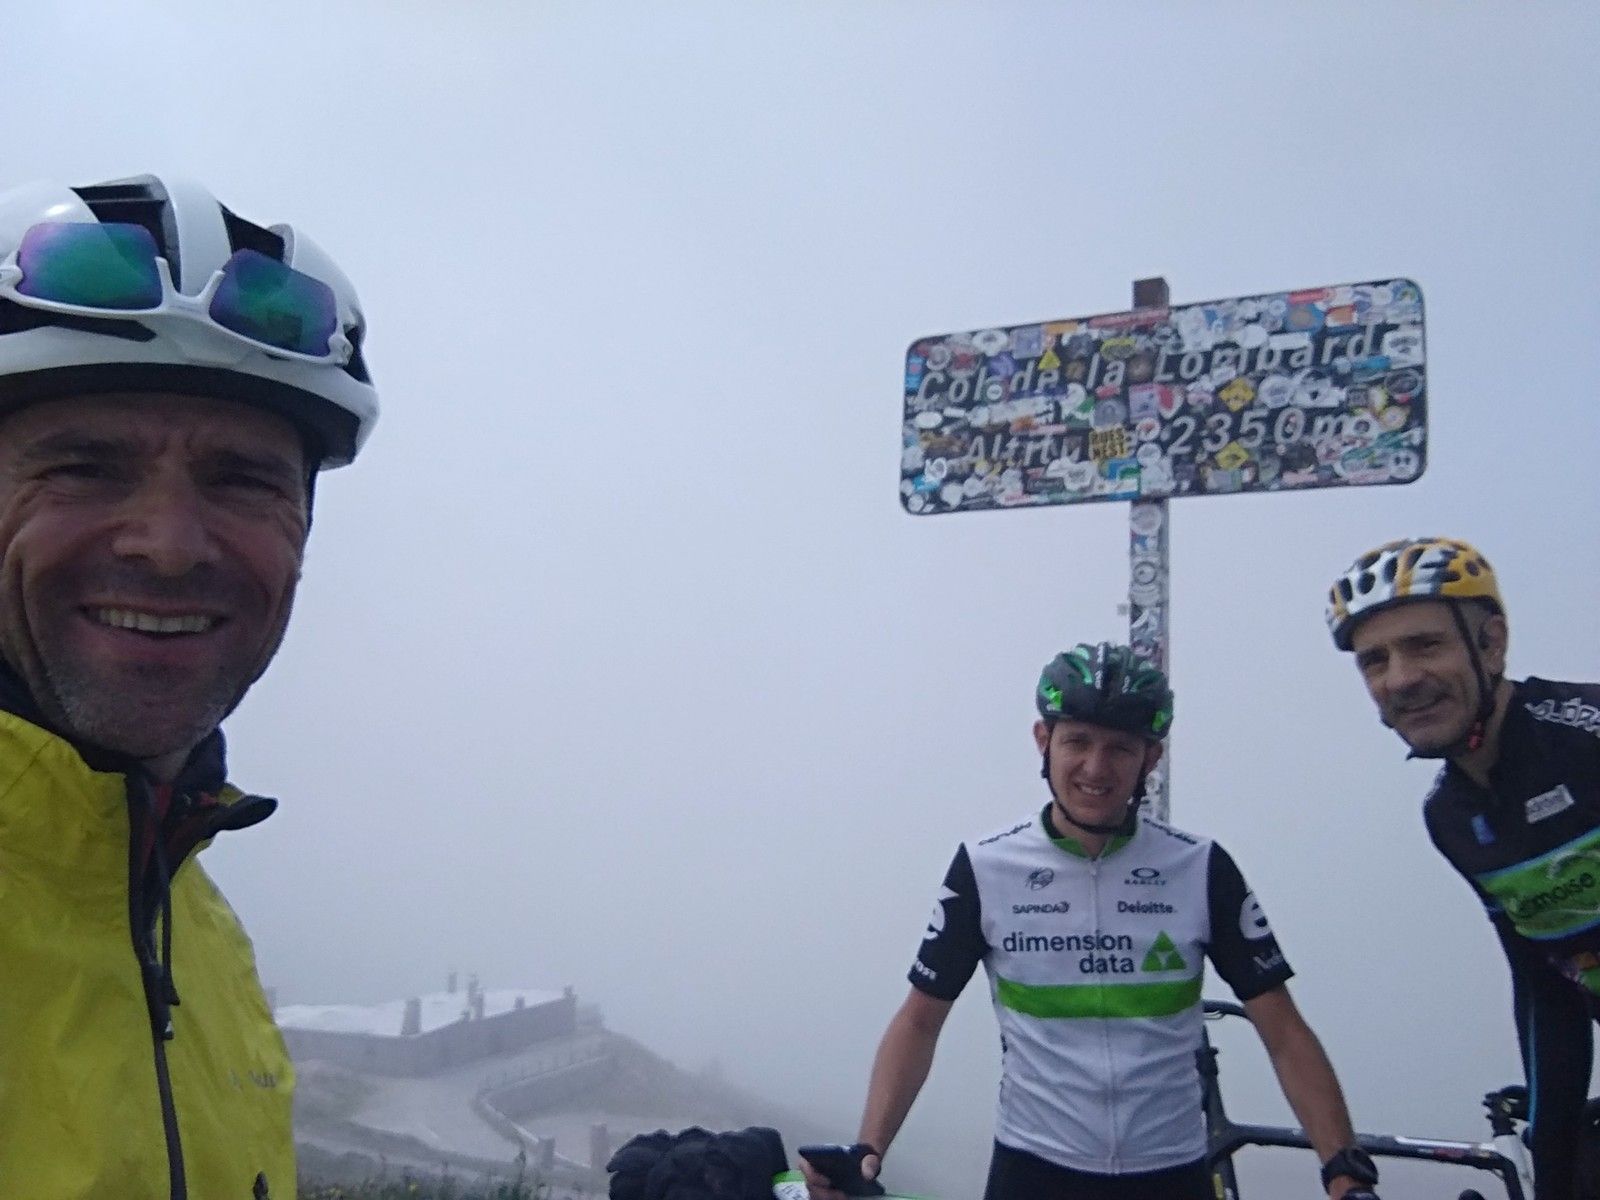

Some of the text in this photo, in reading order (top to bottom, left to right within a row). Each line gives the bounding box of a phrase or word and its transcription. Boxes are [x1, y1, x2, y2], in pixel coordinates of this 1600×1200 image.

[916, 366, 986, 402] Col
[1010, 359, 1060, 393] de
[1085, 352, 1127, 389] la
[1002, 929, 1133, 952] dimension
[1079, 951, 1135, 974] data
